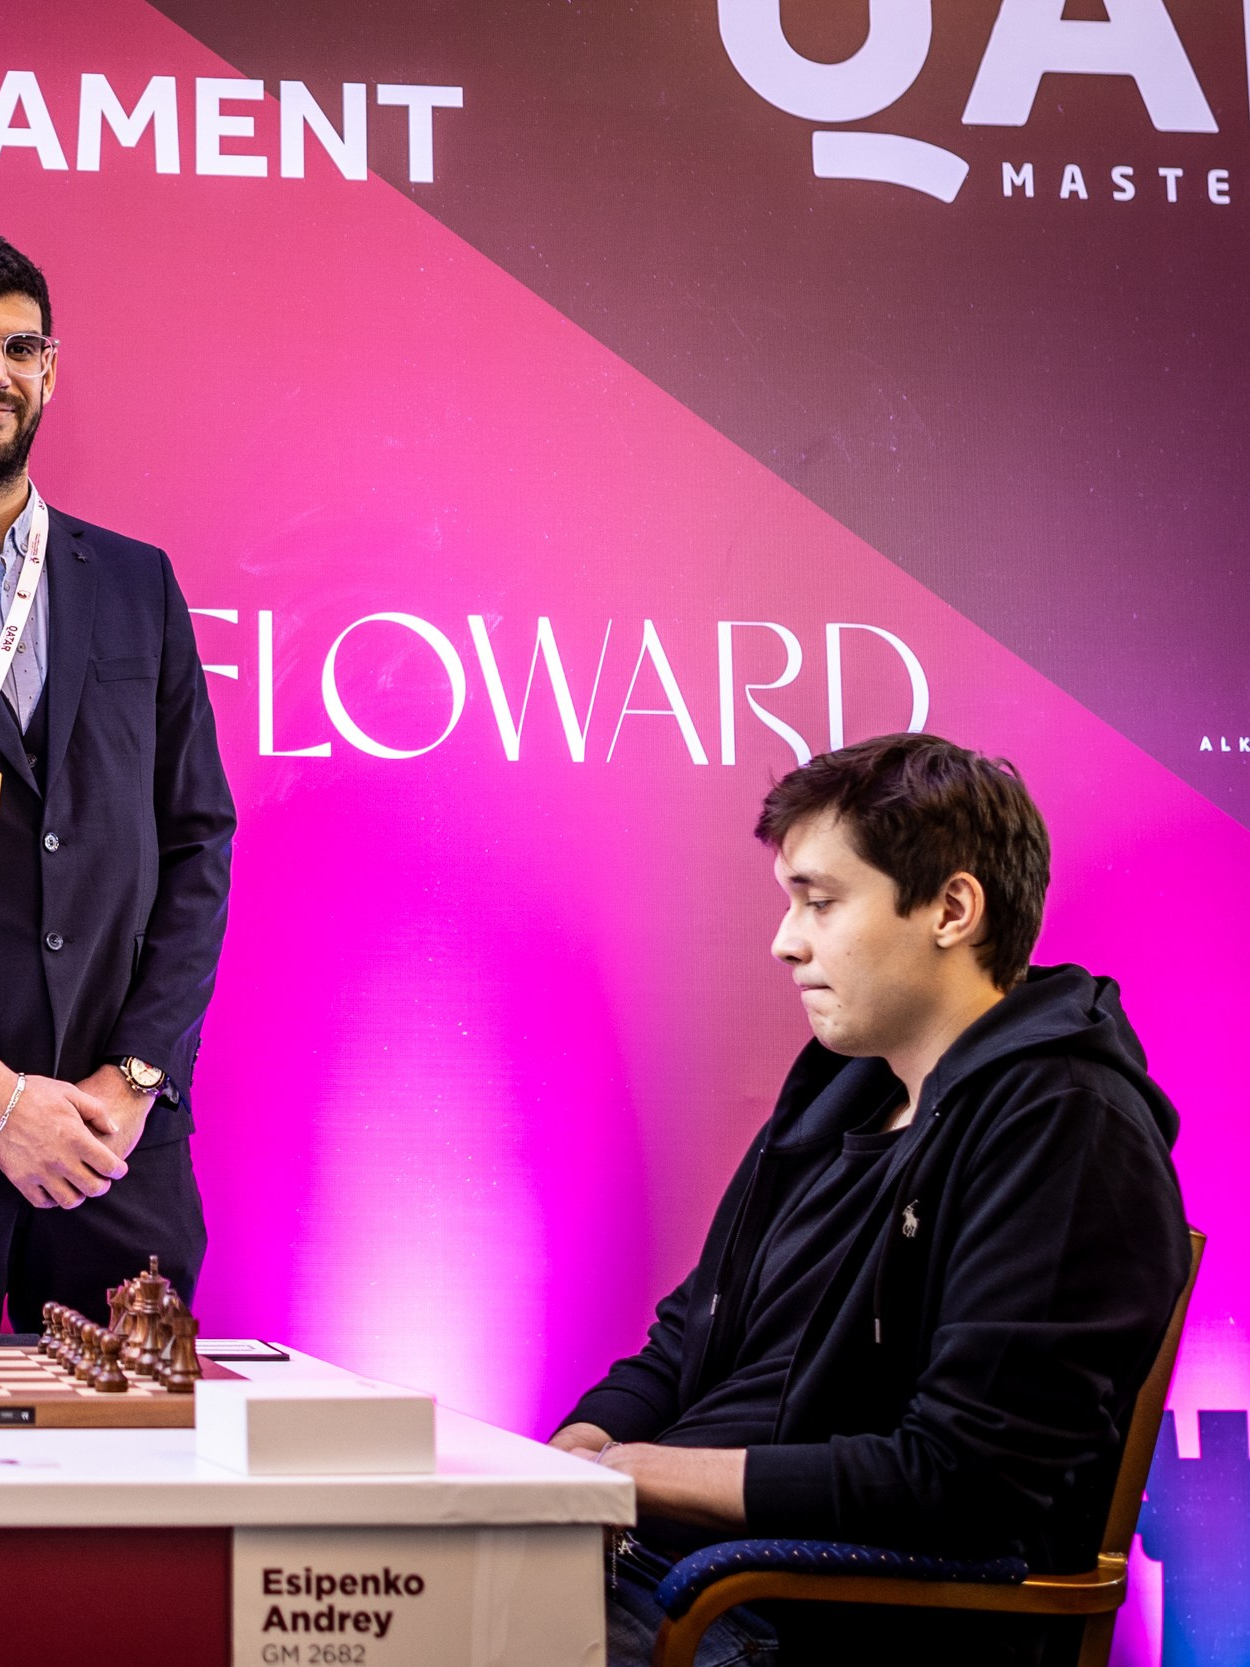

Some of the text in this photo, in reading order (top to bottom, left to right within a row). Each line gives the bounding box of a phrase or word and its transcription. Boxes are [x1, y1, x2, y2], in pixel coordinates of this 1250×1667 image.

[718, 0, 1250, 204] QA
[1002, 162, 1231, 205] MASTE
[1, 625, 18, 652] QATAR
[262, 1567, 426, 1602] Esipenko
[262, 1604, 394, 1639] Andrey
[261, 1643, 367, 1666] GM 2682
